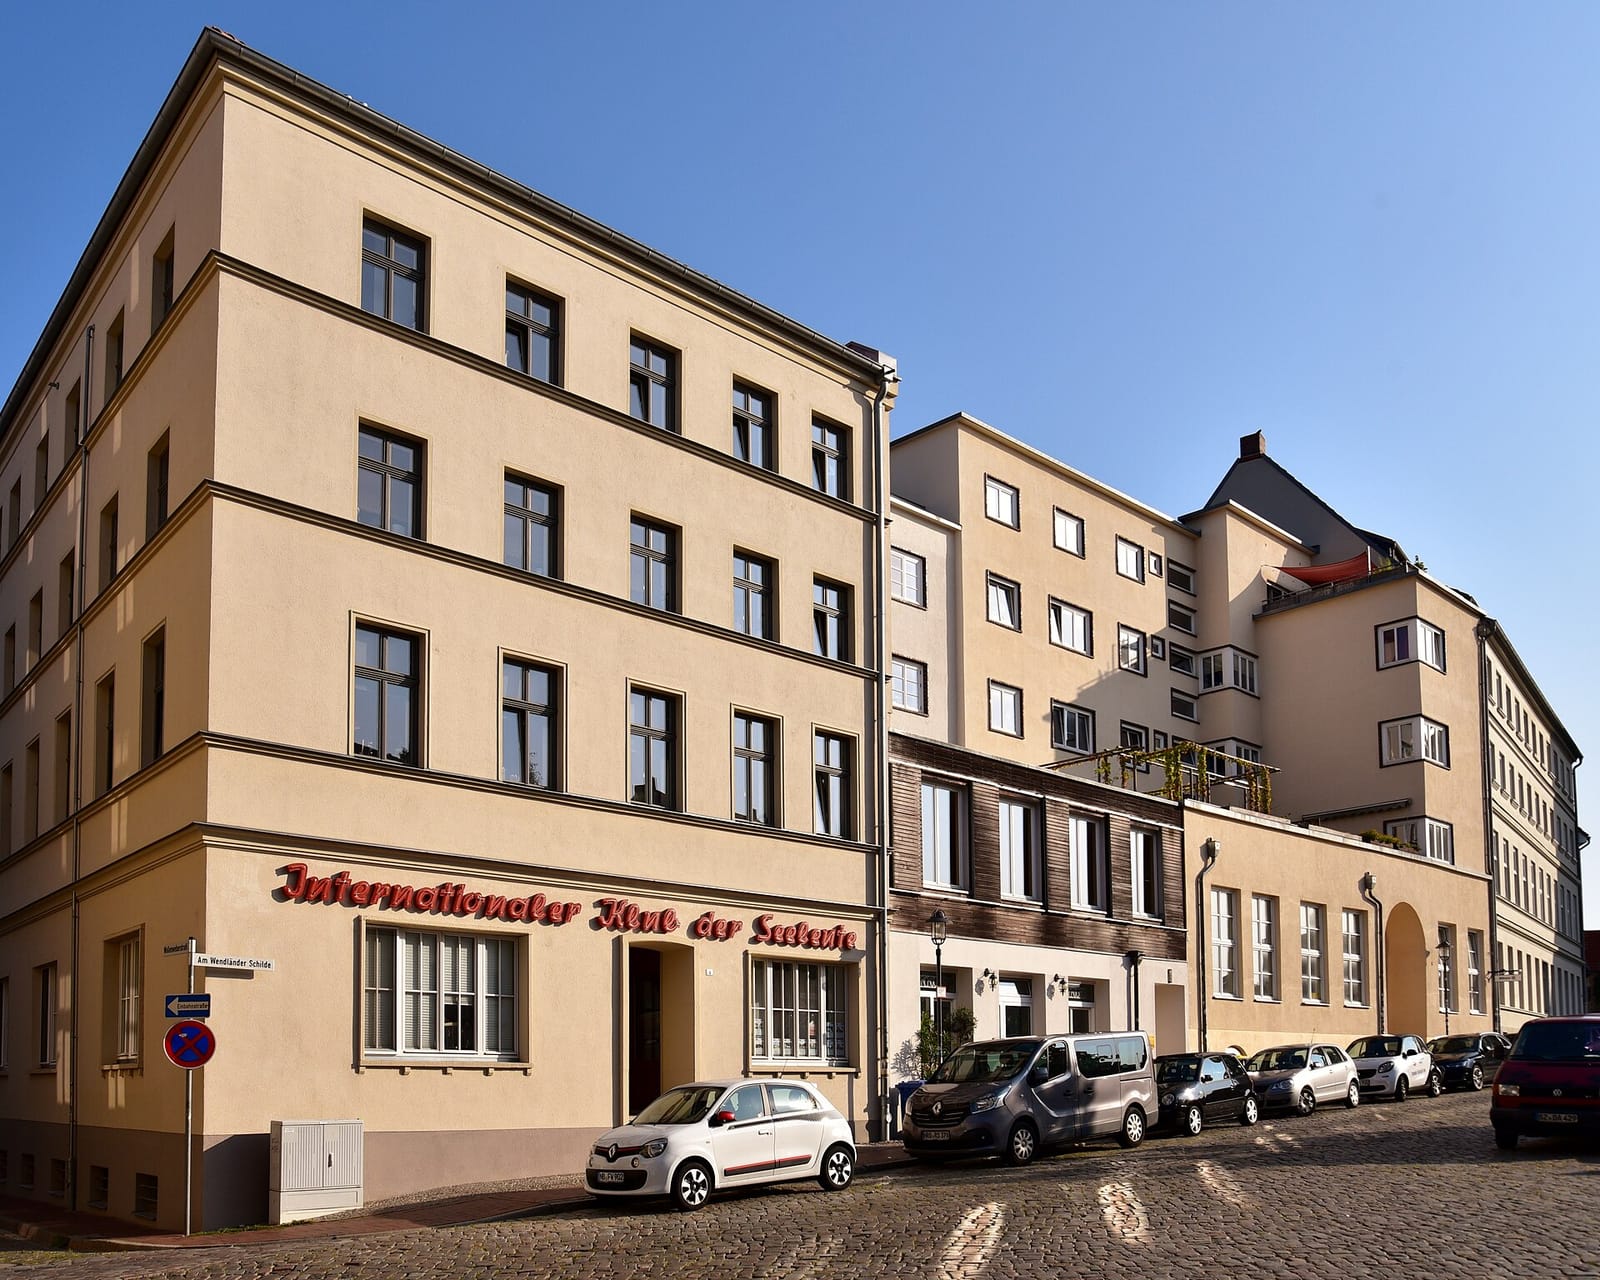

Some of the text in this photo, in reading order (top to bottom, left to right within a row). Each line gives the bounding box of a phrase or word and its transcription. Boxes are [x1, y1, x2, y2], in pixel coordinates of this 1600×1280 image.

[282, 863, 583, 923] Internationaler
[694, 911, 744, 939] der
[757, 914, 858, 950] Seeleute
[197, 956, 271, 969] Am Wendländer Schilde
